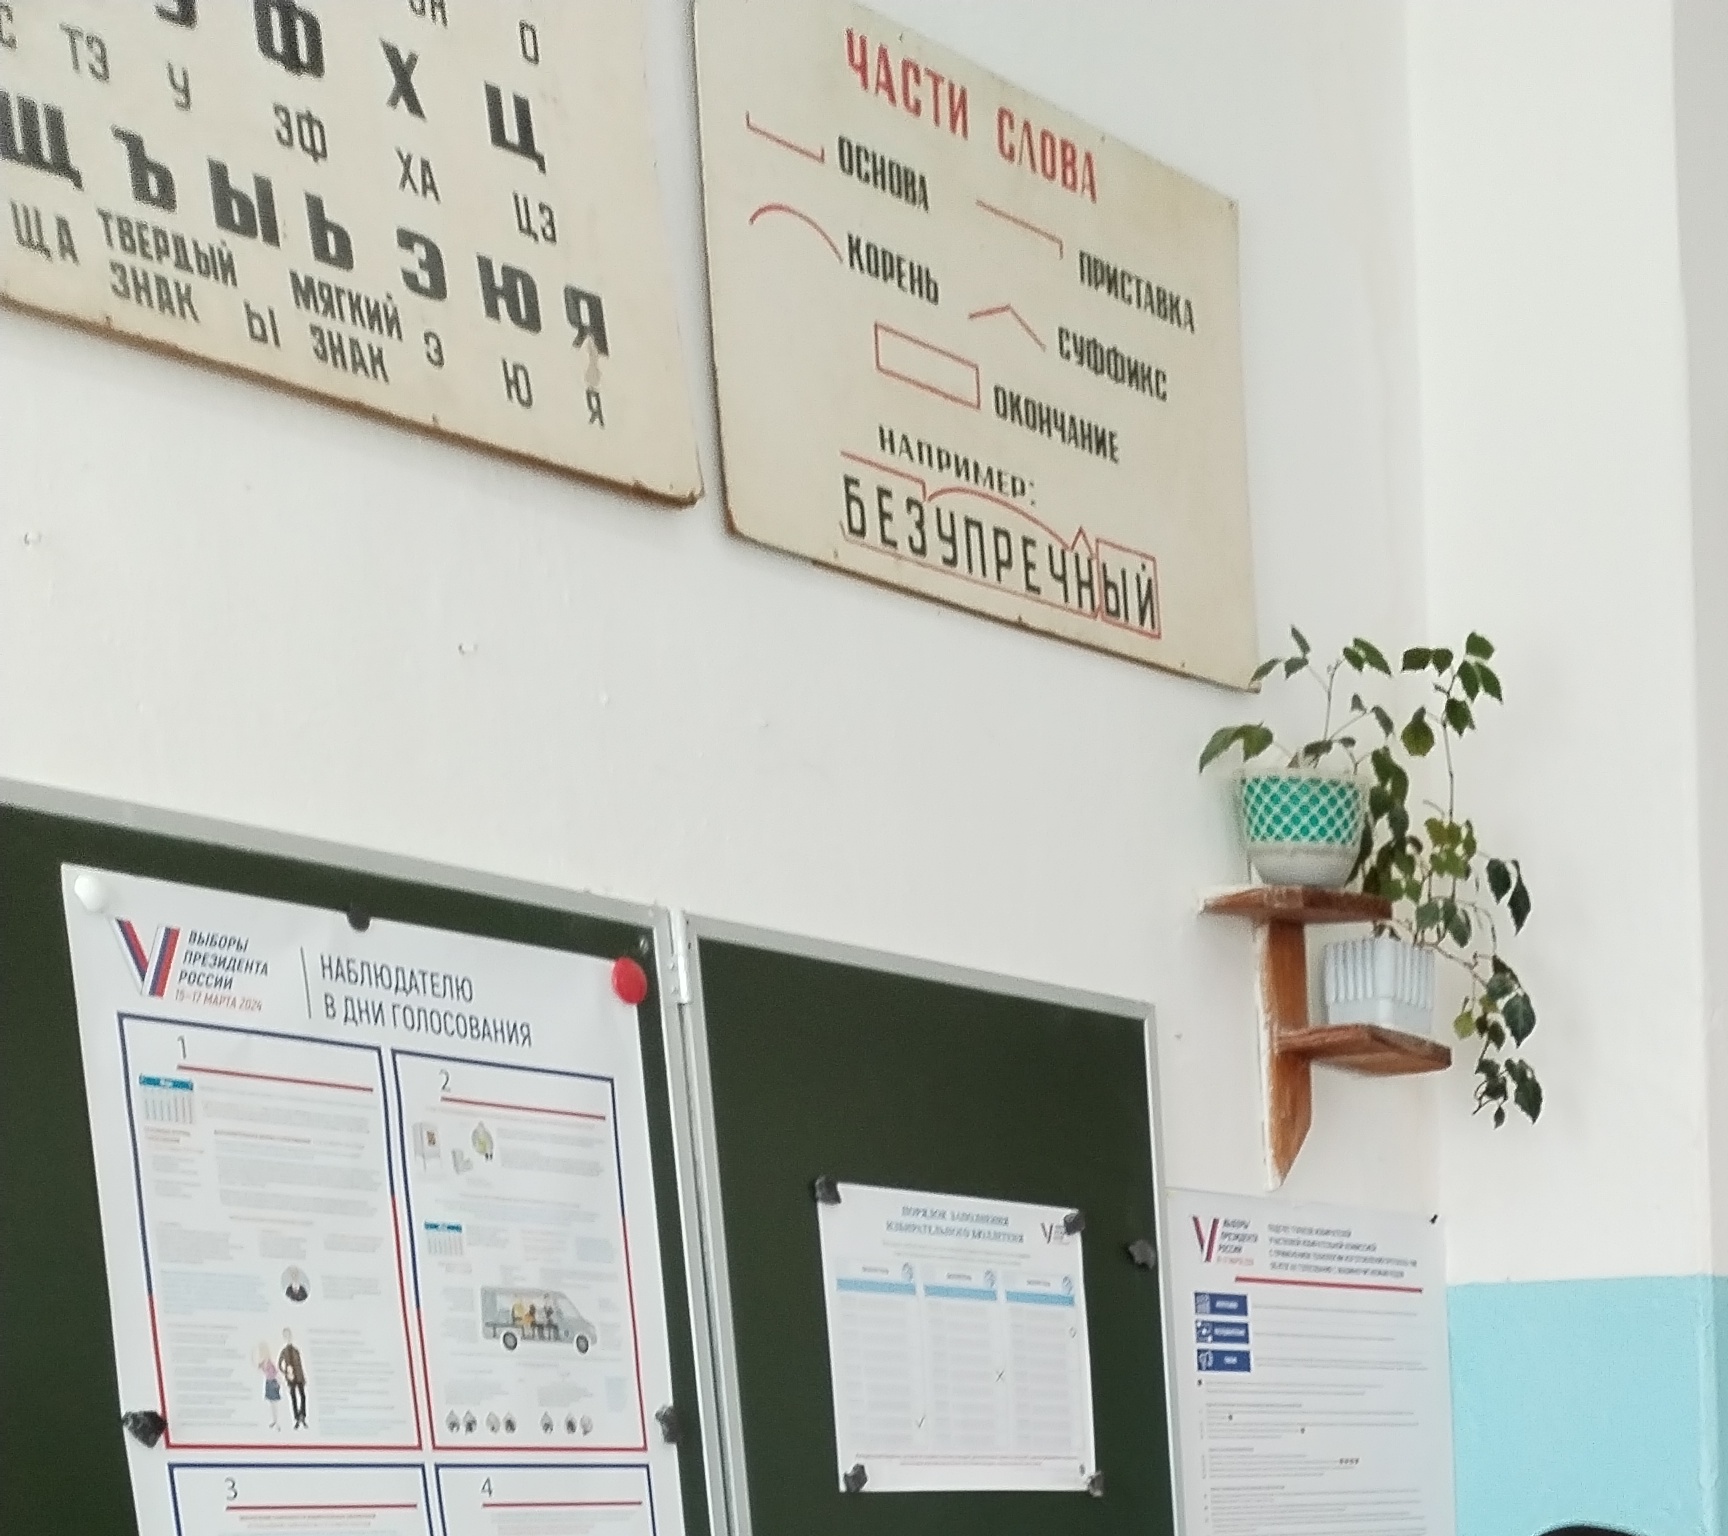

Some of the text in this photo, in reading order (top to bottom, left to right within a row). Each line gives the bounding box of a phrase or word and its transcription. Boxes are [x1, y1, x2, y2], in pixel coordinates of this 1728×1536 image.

[167, 60, 191, 112] У
[395, 146, 441, 204] ХА
[484, 80, 546, 176] Ц
[845, 27, 1098, 204] ЧАСТИ СЛОВА
[838, 135, 930, 212] ОСНОВА
[110, 123, 177, 213] Ъ
[207, 155, 281, 249] Ы
[304, 191, 355, 272] Ь
[396, 226, 448, 301] Э
[476, 252, 542, 335] Ю
[563, 284, 609, 357] Я
[847, 232, 940, 305] КОРЕНЬ
[10, 199, 80, 266] ЩА
[96, 207, 238, 288] ТВЕРДЫЙ
[289, 269, 403, 343] МЯГКИЙ
[501, 357, 533, 409] Ю
[586, 387, 605, 427] Я
[110, 260, 200, 322] ЗНАК
[1078, 249, 1196, 334] ПРИСТАВКА
[309, 321, 390, 384] ЗНАК
[1057, 326, 1168, 402] СУФФИКС
[993, 384, 1120, 465] ОКОНЧАНИЕ
[878, 424, 1036, 506] НАПРИМЕР:
[843, 474, 1158, 632] БЕЗУПРЕЧНЫЙ
[183, 949, 269, 977] ПРЕЗИДЕНТА
[188, 929, 249, 953] ВЫБОРЫ
[178, 970, 234, 990] РОССИИ
[203, 993, 237, 1009] МАРТА
[319, 952, 475, 1004] НАБЛЮДАТЕЛЮ
[177, 1036, 187, 1060] 1
[324, 993, 533, 1049] В ДНИ ГОЛОСОВАНИЯ
[439, 1069, 452, 1094] 2
[224, 1477, 239, 1501] 3
[481, 1476, 494, 1497] 4
